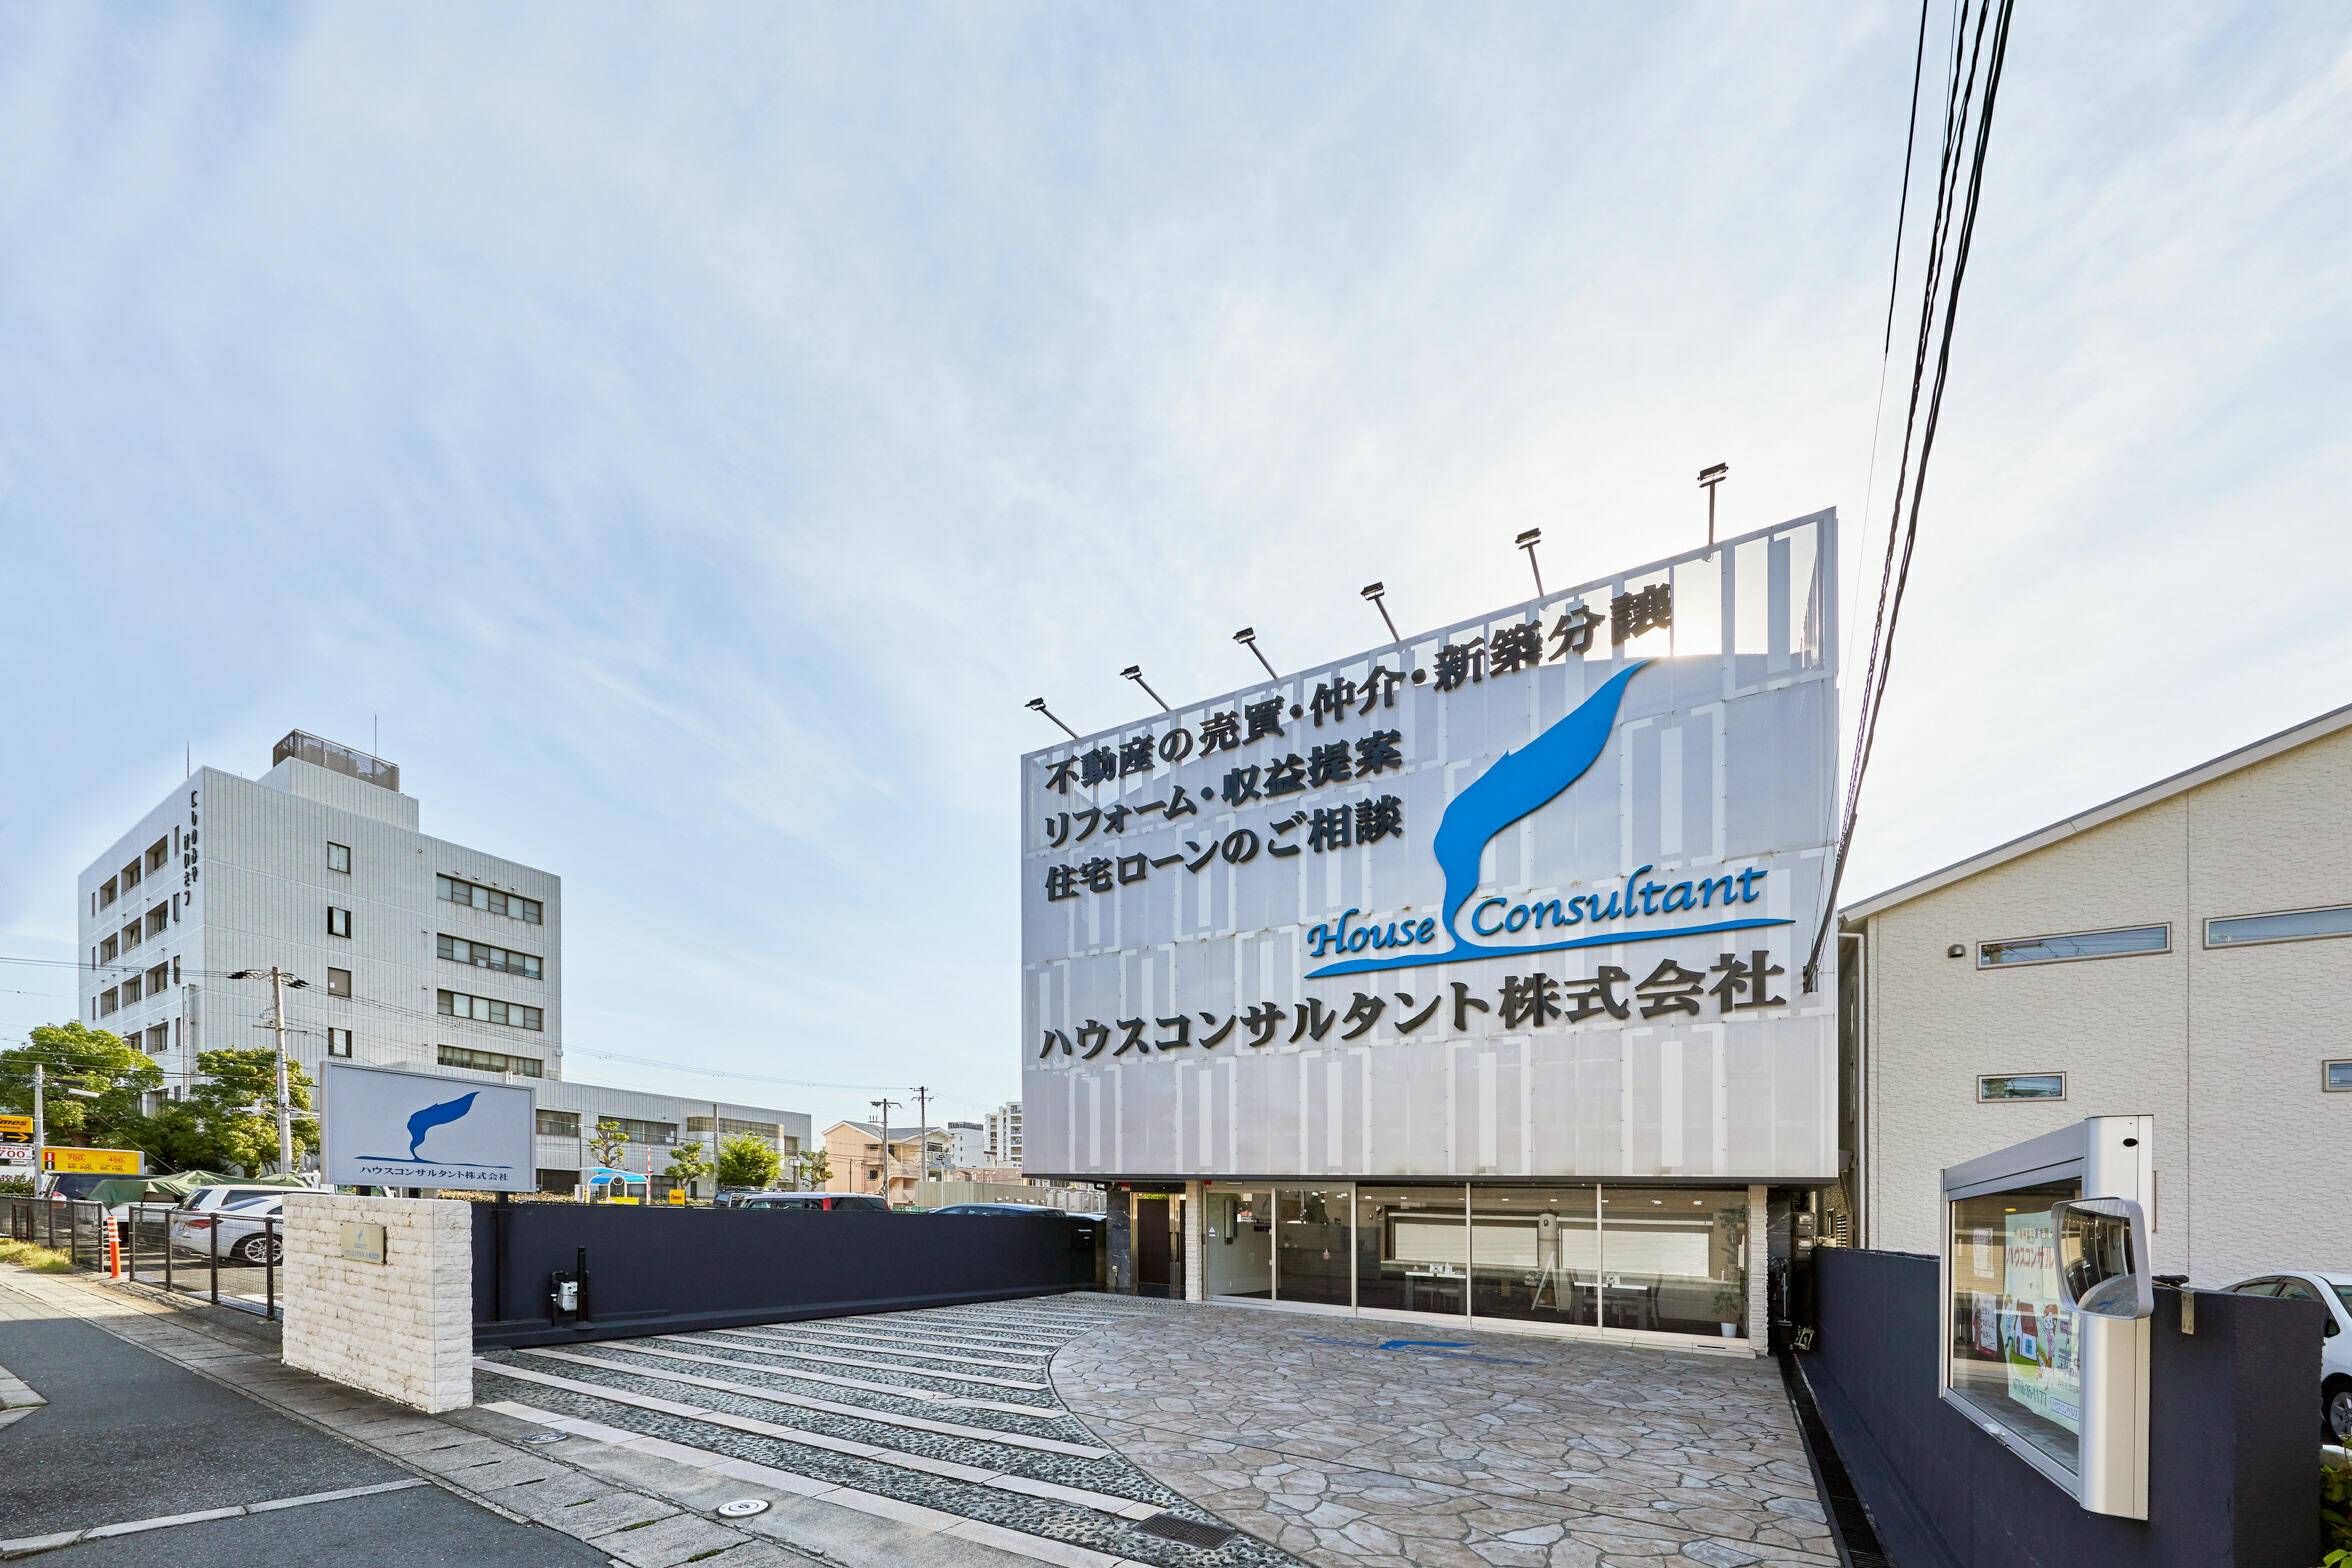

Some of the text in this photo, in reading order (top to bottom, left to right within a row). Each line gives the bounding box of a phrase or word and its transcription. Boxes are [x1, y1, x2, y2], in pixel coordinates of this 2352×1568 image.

[1045, 583, 1672, 794] 不動産の売買・仲介・新築分譲
[1045, 729, 1402, 848] リフォーム・収益提案
[1045, 794, 1403, 902] 住宅ローンのご相談
[1307, 864, 1768, 957] House Consultant
[1039, 949, 1787, 1060] ハウスコンサルタント株式会社
[360, 1166, 509, 1182] ハウスコンサルタント株式会社
